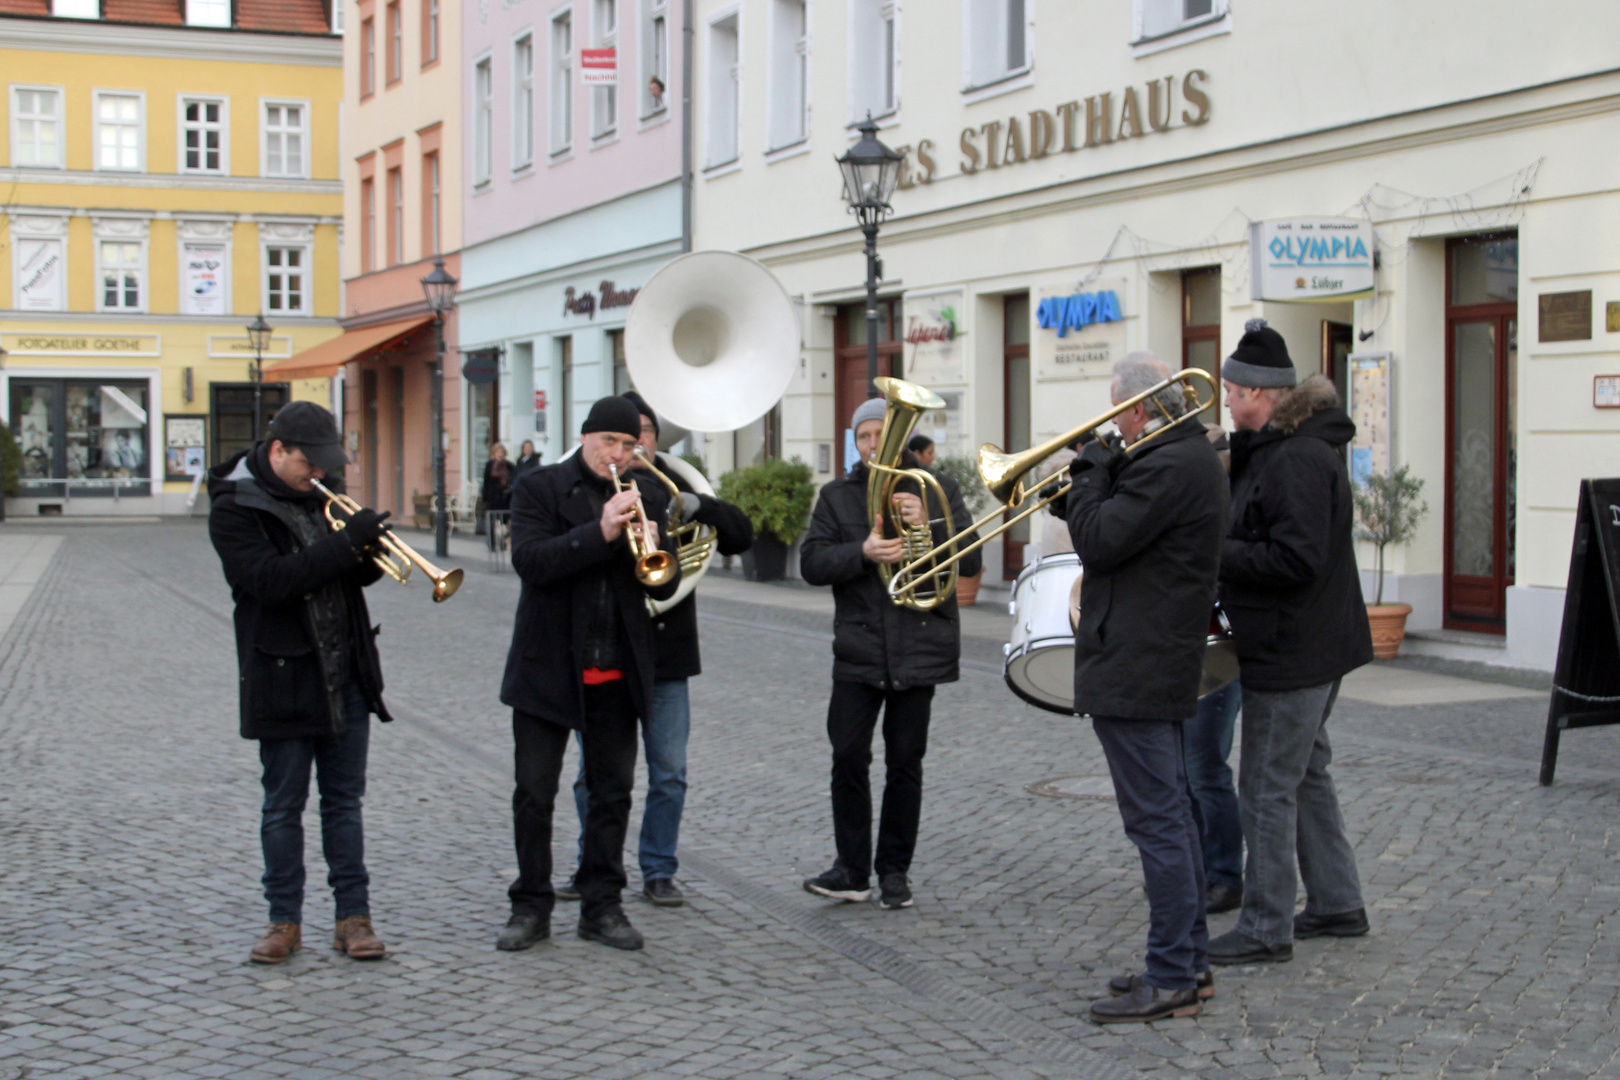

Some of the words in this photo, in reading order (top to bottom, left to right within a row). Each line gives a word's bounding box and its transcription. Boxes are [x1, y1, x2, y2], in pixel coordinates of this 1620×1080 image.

[960, 68, 1210, 175] STADTHAUS
[1268, 235, 1369, 266] OLYMPIA
[1036, 290, 1121, 338] OLYMPIA
[17, 337, 88, 350] FOTOATELIER
[93, 339, 142, 351] GOETHE
